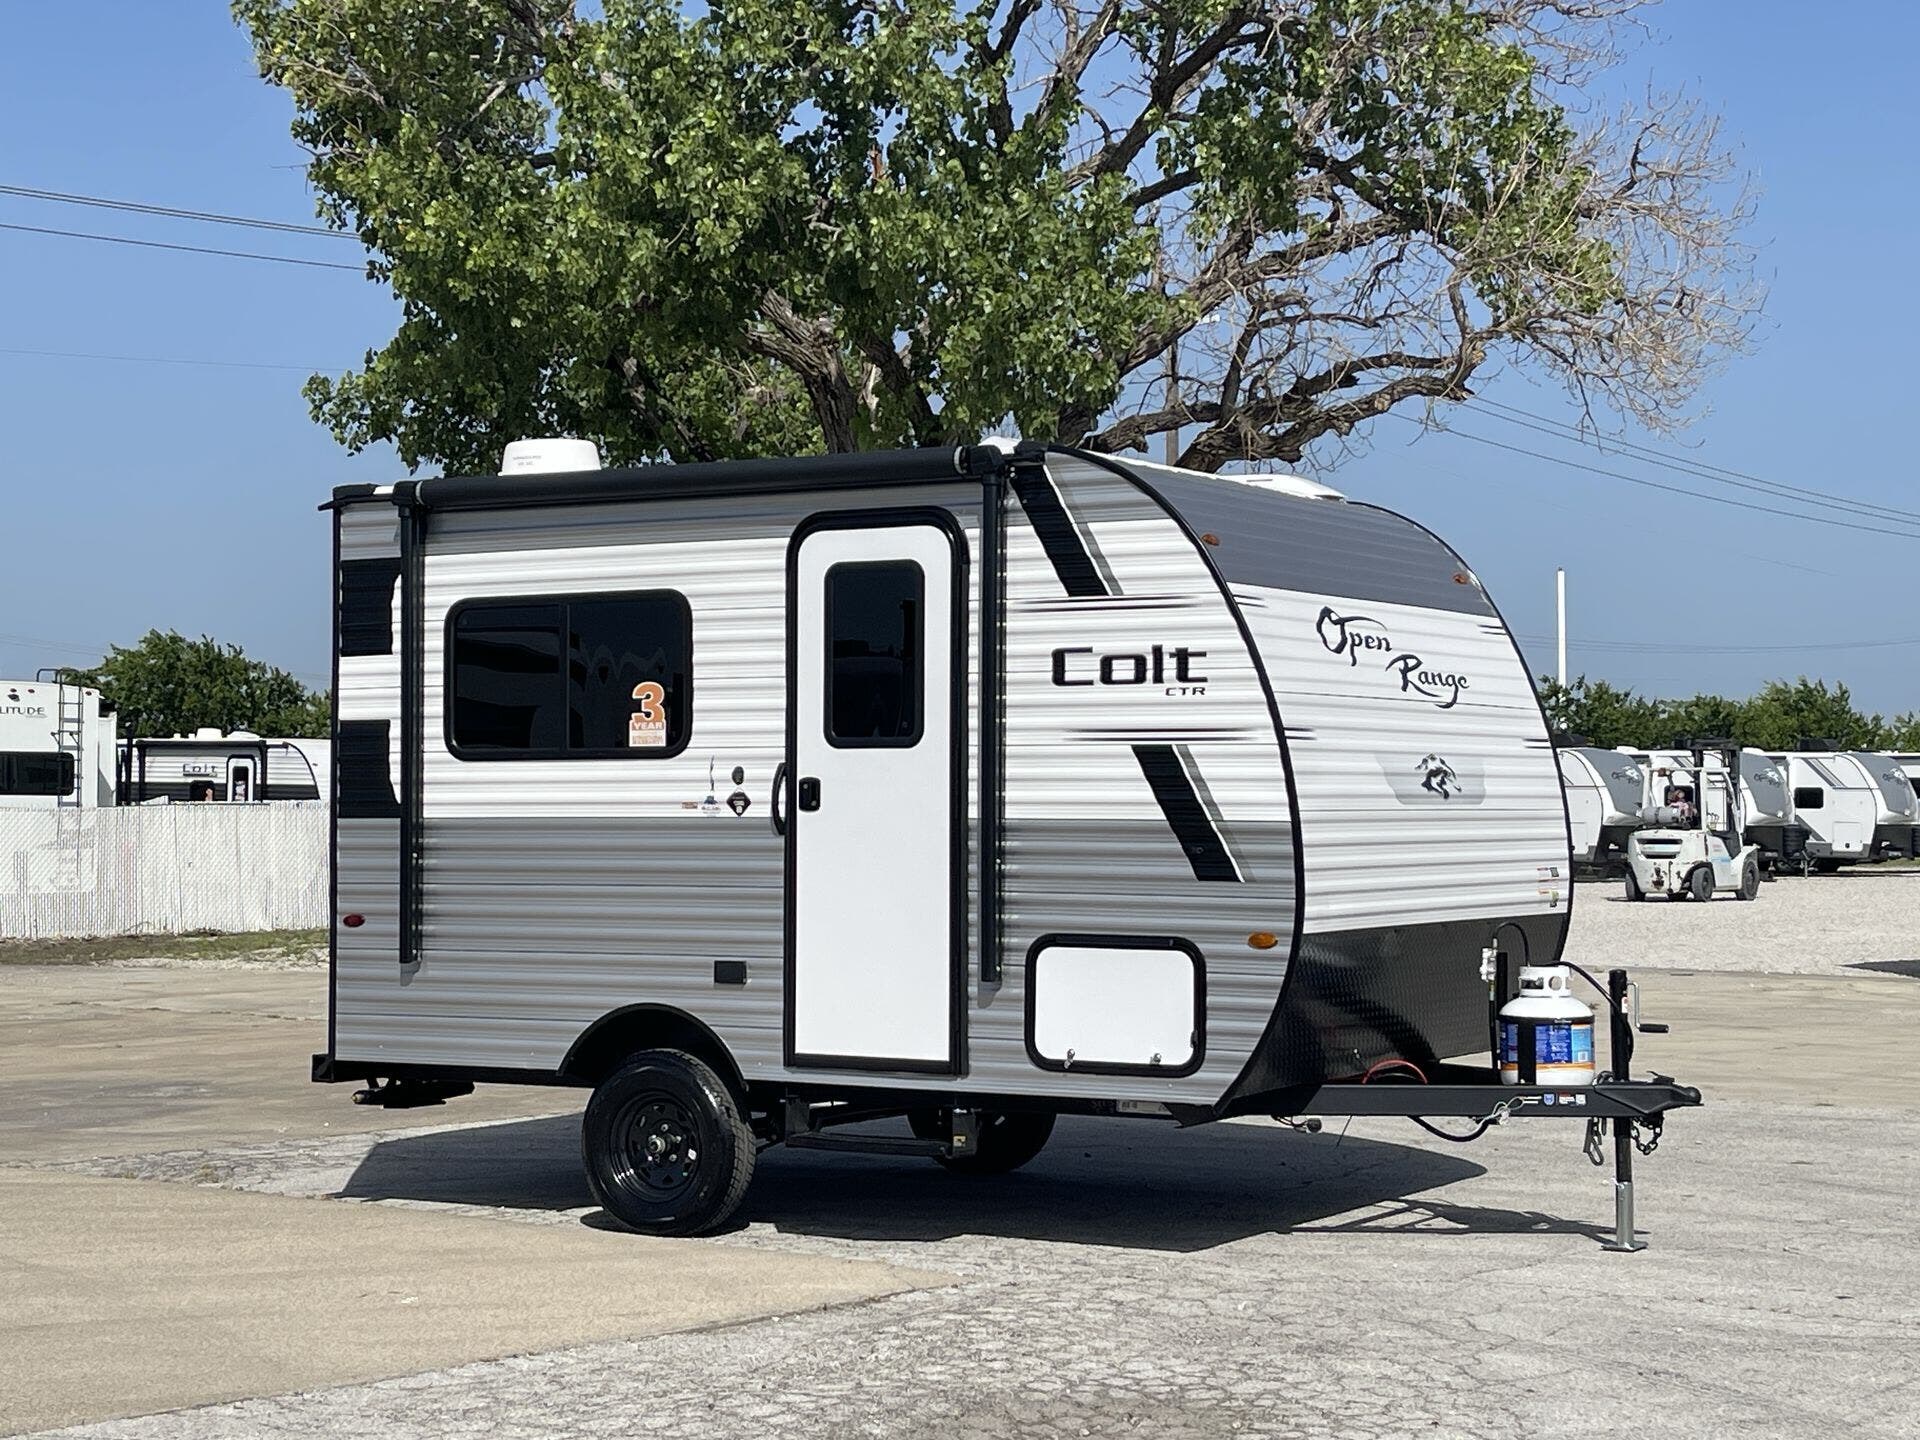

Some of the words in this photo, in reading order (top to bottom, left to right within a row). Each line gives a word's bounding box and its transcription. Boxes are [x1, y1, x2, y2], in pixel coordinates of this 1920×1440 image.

[1051, 644, 1208, 686] Colt
[1316, 606, 1392, 667] Open
[1385, 654, 1470, 709] Range
[0, 706, 45, 715] LITUDE
[632, 682, 665, 722] 3
[1165, 686, 1206, 696] CTR
